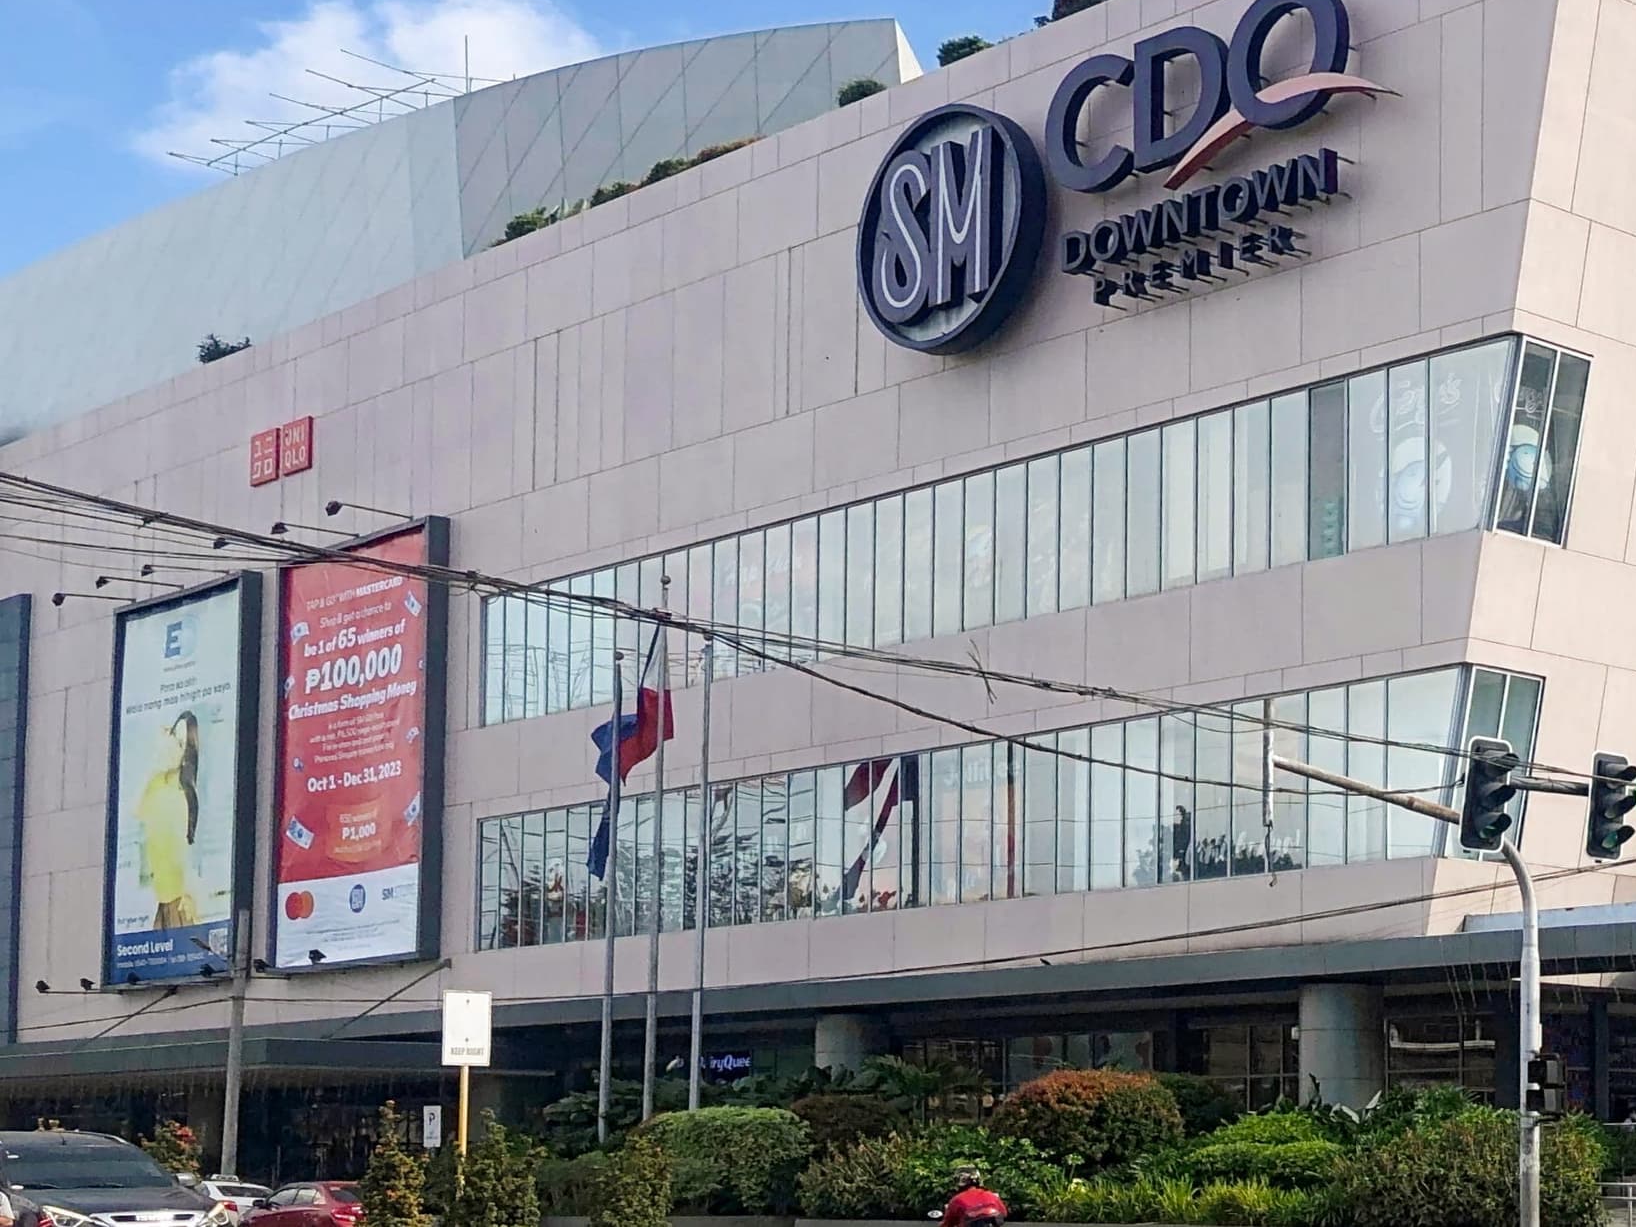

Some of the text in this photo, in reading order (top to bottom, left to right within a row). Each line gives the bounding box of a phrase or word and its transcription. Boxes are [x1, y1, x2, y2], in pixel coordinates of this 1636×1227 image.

[872, 125, 1000, 325] SM
[1062, 147, 1338, 275] DOWNTOWN
[1092, 226, 1299, 306] PREMIER
[356, 576, 404, 597] MASTERCARD
[304, 643, 317, 657] be
[325, 637, 337, 652] of
[338, 627, 356, 649] 65
[357, 624, 393, 645] winners
[394, 618, 406, 635] of
[288, 698, 339, 721] Christmas
[340, 685, 386, 711] Shopping
[387, 680, 417, 699] Money
[307, 775, 328, 792] Oct
[329, 774, 336, 789] 1
[343, 772, 362, 788] Dec
[378, 760, 402, 780] 2023
[117, 938, 174, 957] Second Level
[450, 1046, 484, 1056] KEEP RIGHT
